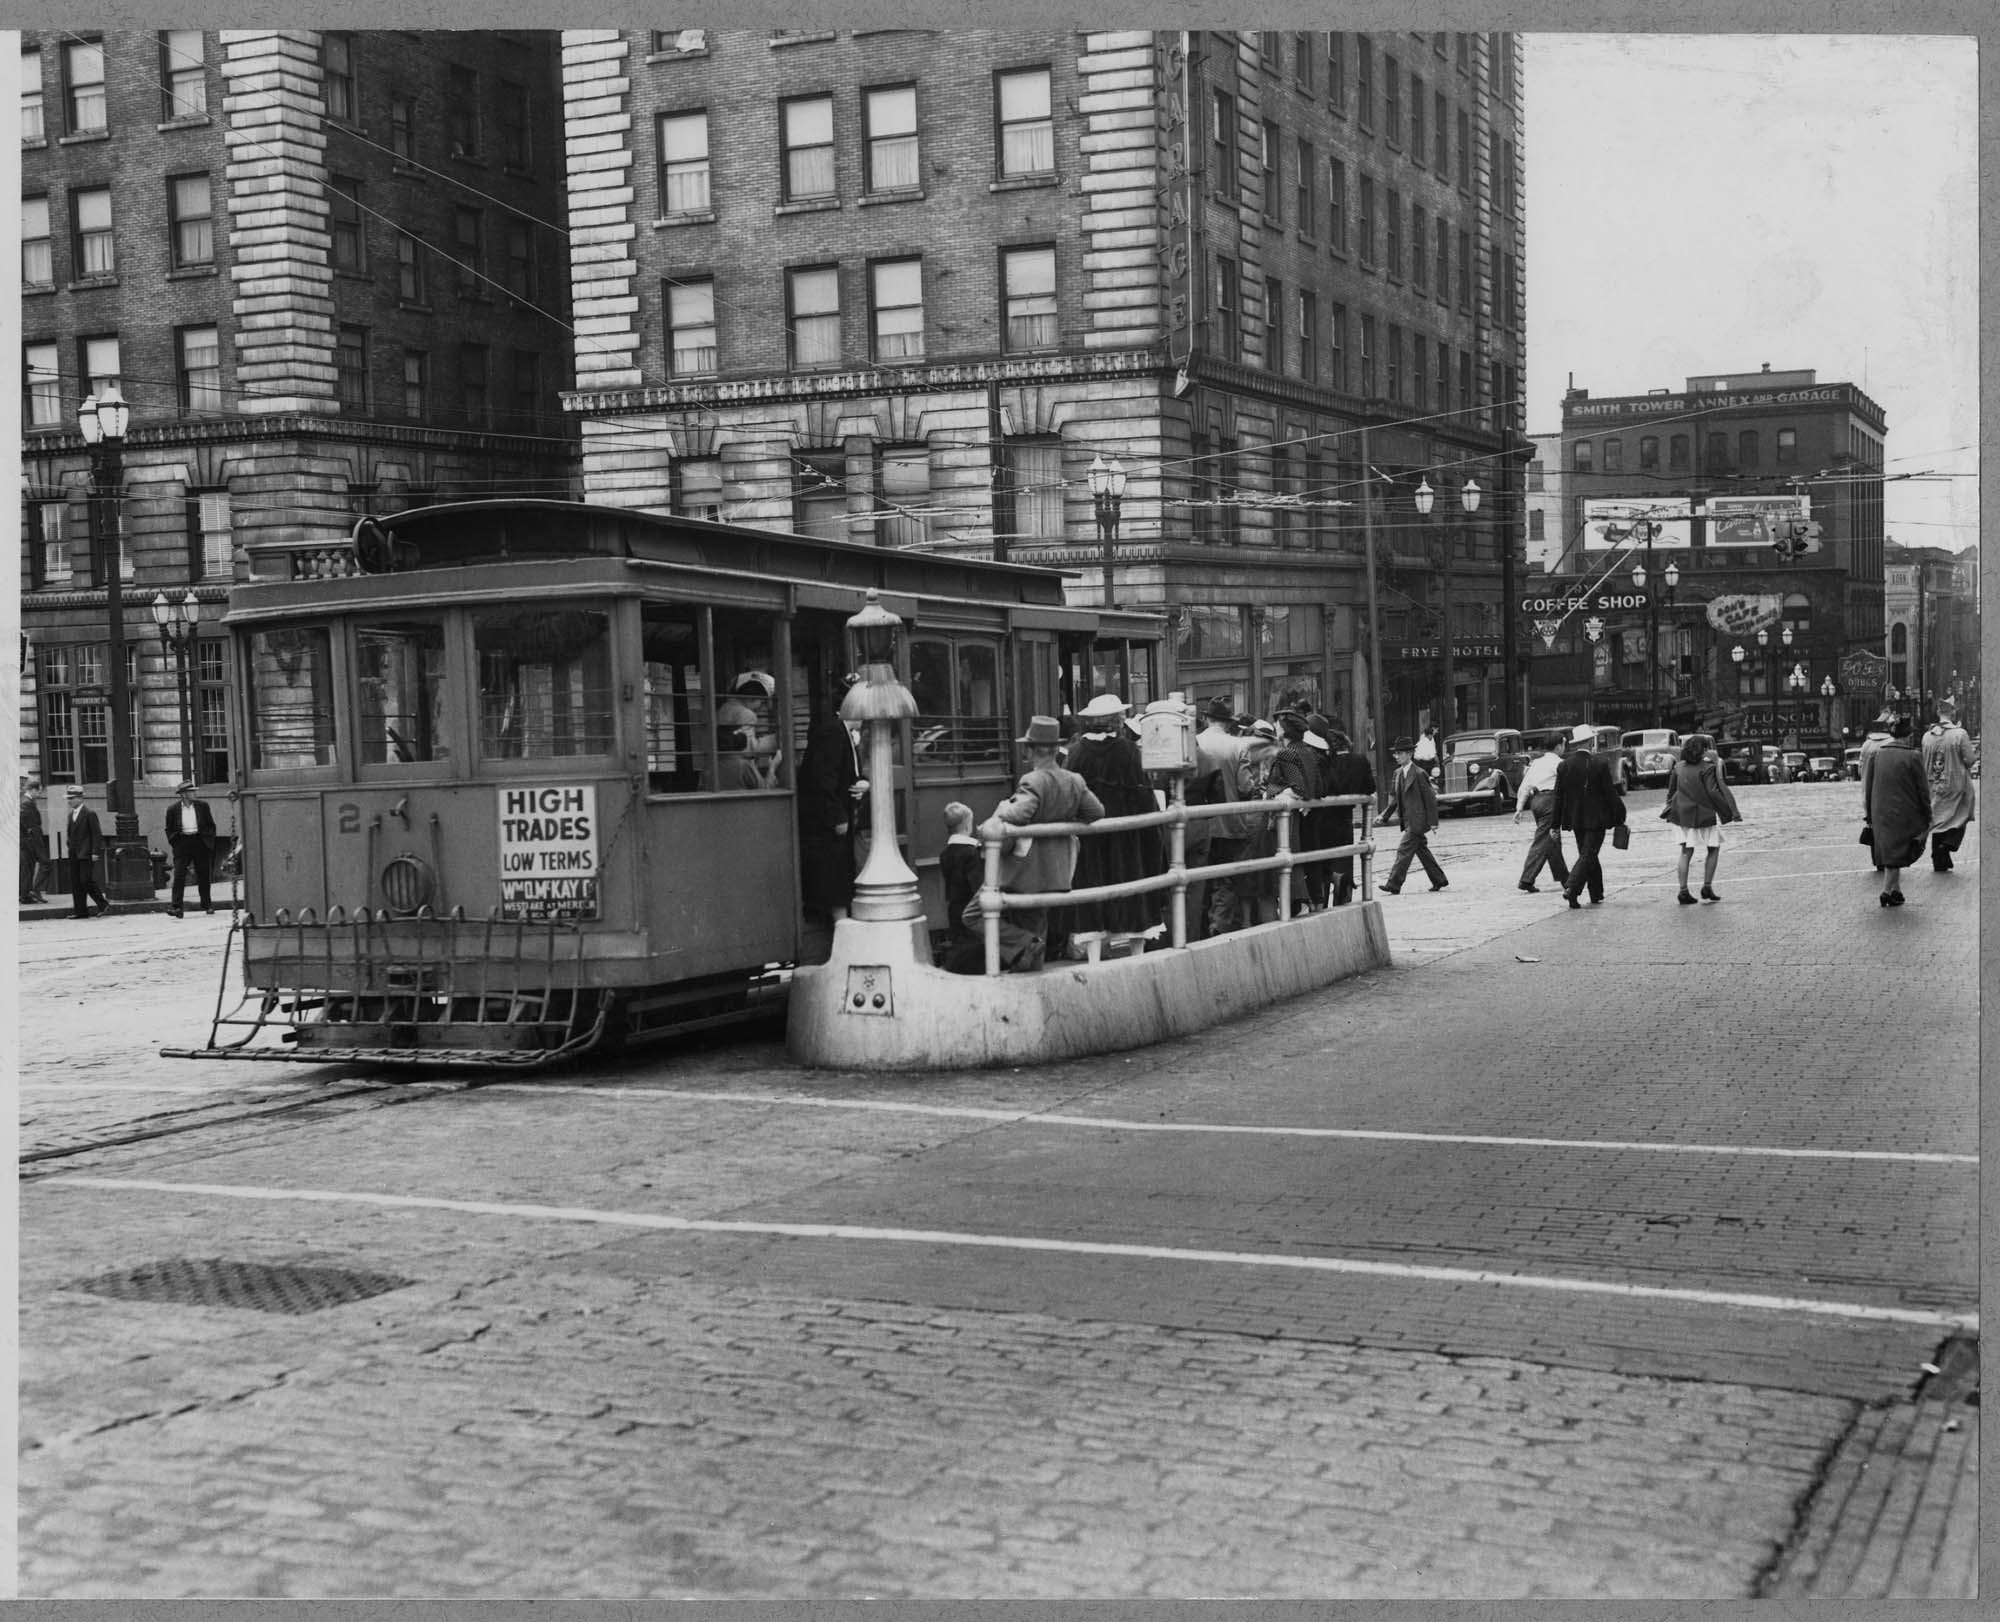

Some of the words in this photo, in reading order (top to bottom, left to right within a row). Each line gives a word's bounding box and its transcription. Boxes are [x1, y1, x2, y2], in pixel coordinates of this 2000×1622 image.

[1571, 403, 1620, 416] SMITH
[1628, 400, 1685, 413] TOWER
[1693, 395, 1749, 409] ANNEX
[1752, 393, 1774, 403] AND
[1776, 389, 1841, 404] GARAGE
[1522, 598, 1590, 612] COFFEE
[1598, 595, 1647, 609] SHOP
[1401, 647, 1439, 658] FRYE
[1452, 646, 1502, 657] HOTEL
[1751, 712, 1815, 724] LUNCH
[507, 789, 584, 814] HIGH
[338, 803, 361, 834] 2
[502, 817, 591, 842] TRADES
[504, 852, 535, 872] LOW
[539, 850, 592, 871] TERMS
[558, 900, 595, 910] MERCR
